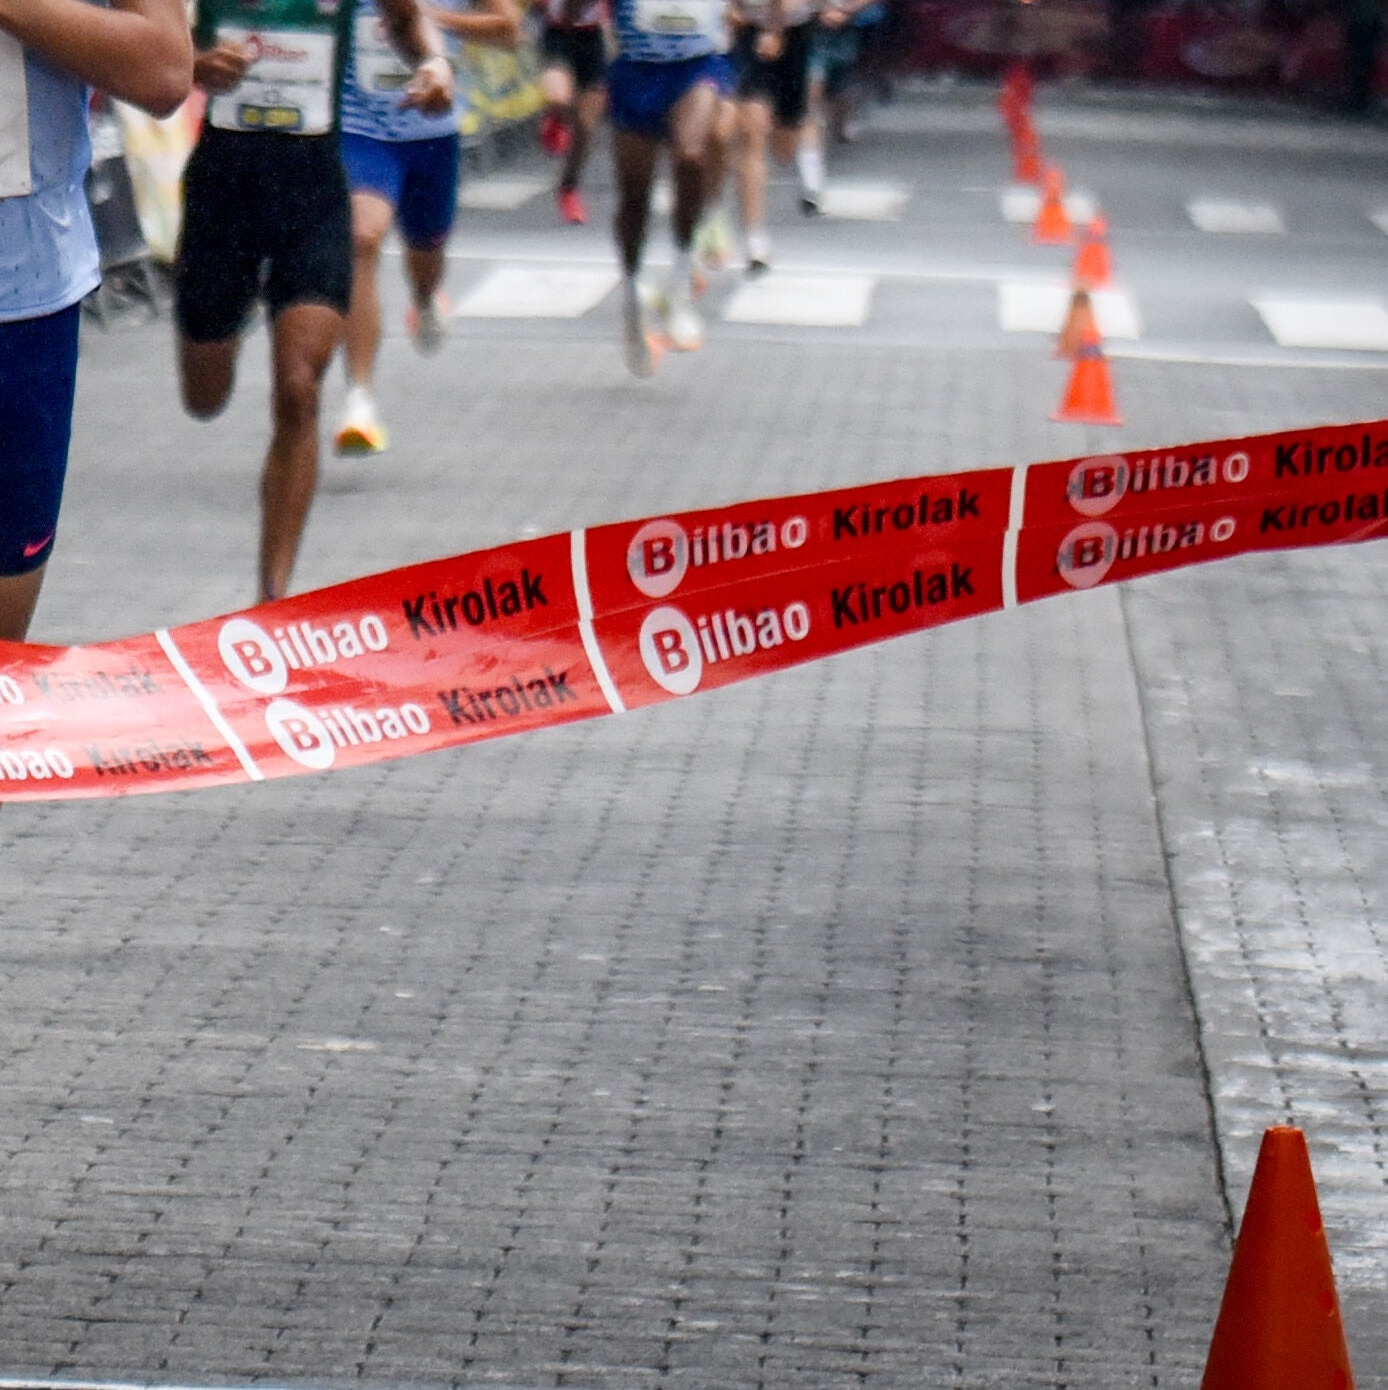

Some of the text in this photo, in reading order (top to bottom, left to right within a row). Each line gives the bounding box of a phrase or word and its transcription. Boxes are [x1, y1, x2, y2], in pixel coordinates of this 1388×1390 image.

[1274, 435, 1388, 478] Kirola
[634, 488, 982, 588] Bilbao Kirolak
[1259, 487, 1388, 534] Kirola
[222, 567, 550, 686] Bilbao Kirolak
[646, 562, 977, 686] Bilbao Kirolak
[272, 666, 580, 763] Bilbao Kirolak
